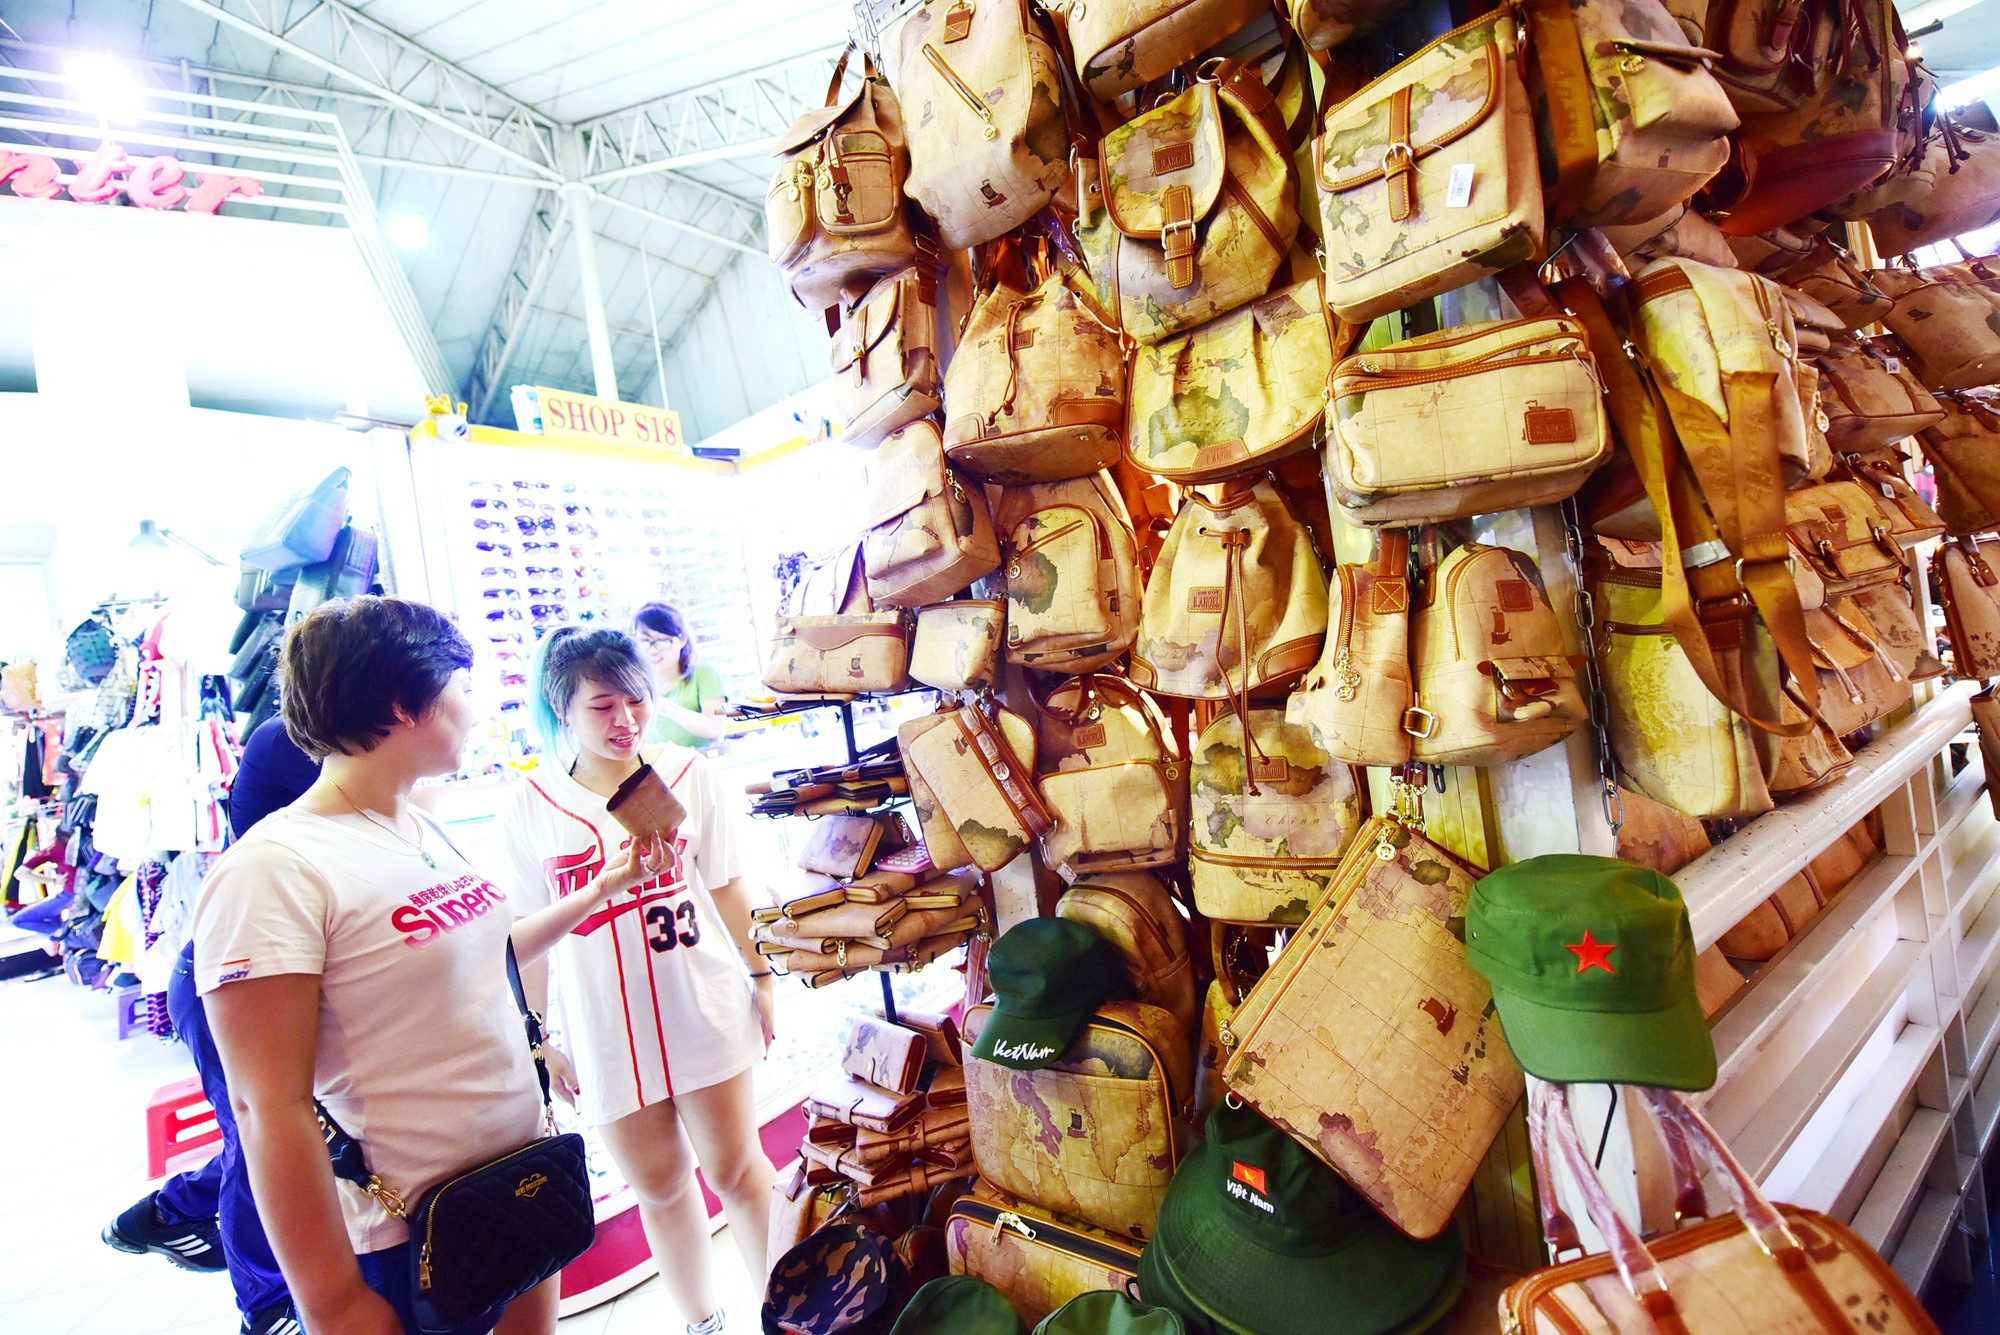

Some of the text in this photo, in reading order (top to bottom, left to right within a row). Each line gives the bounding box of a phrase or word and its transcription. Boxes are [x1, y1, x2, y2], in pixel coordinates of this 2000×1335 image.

[547, 397, 677, 446] SHOP S18
[1264, 814, 1321, 826] China
[646, 899, 700, 953] 33
[1249, 1192, 1275, 1214] Nam
